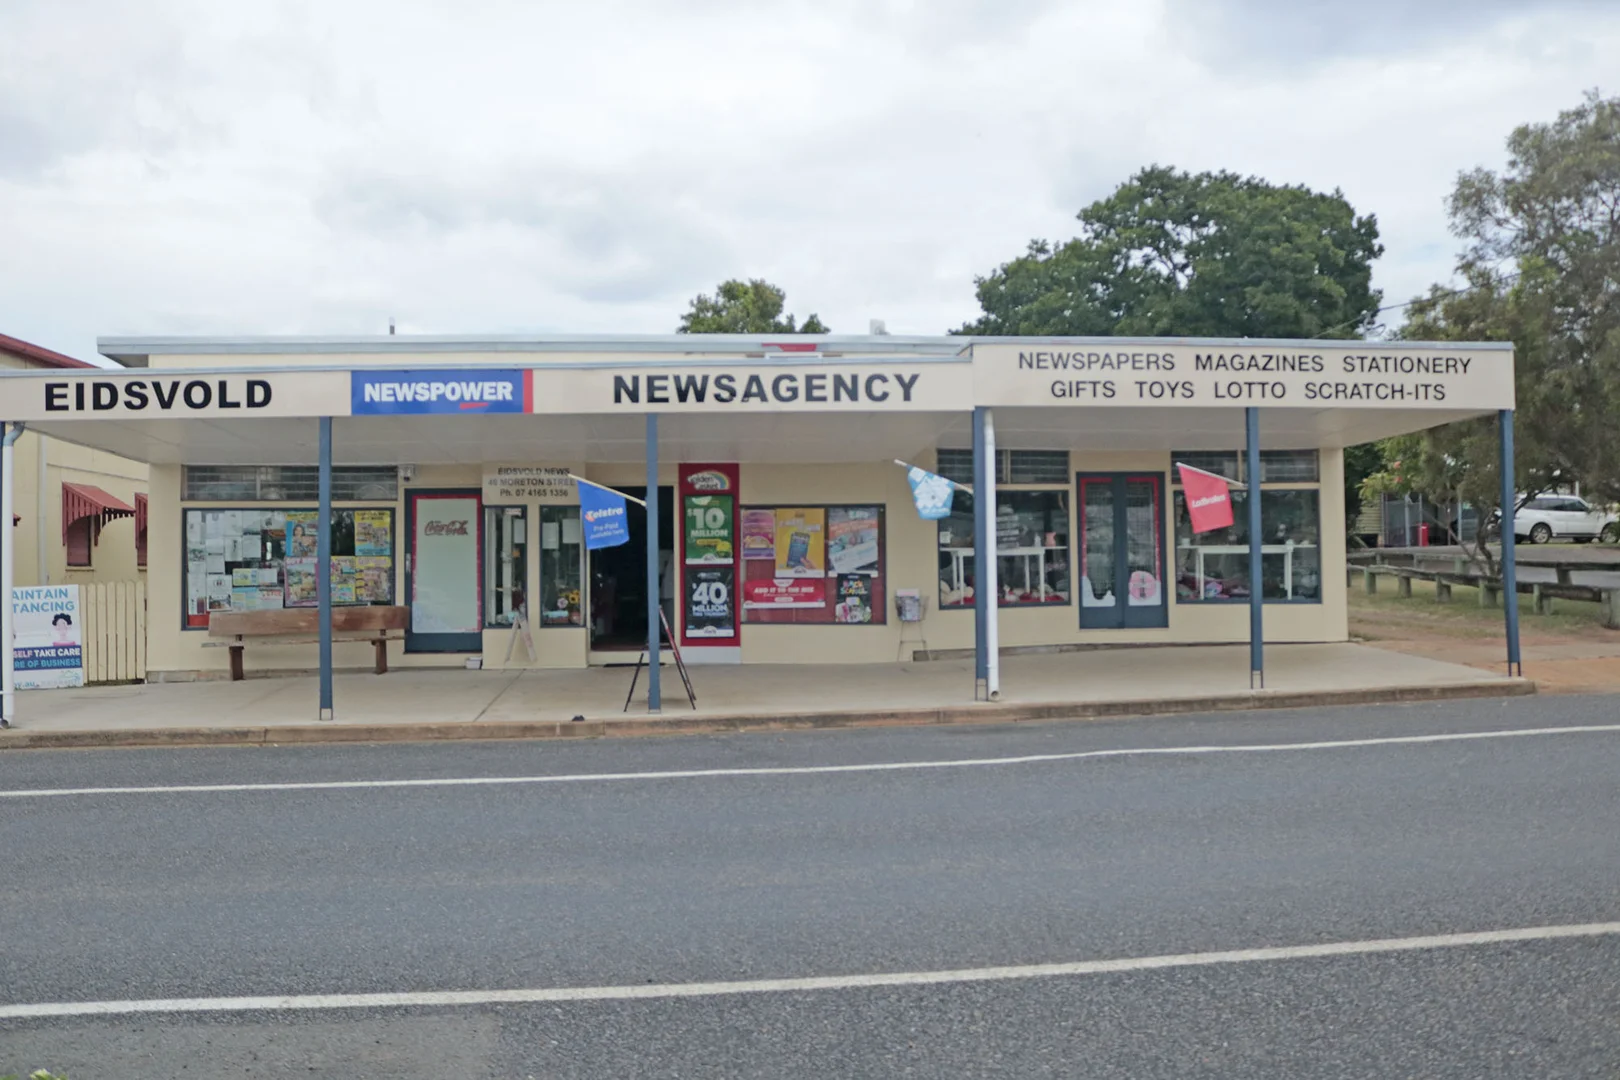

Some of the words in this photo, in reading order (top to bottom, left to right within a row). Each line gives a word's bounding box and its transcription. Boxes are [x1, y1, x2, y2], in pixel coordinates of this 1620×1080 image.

[1018, 352, 1175, 370] NEWSPAPERS
[1195, 353, 1324, 372] MAGAZINES
[1343, 355, 1472, 374] STATIONERY
[364, 381, 513, 402] NEWSPOWER
[613, 373, 920, 404] NEWSAGENCY
[1051, 380, 1116, 398] GIFTS
[1135, 381, 1195, 398] TOYS
[1214, 381, 1286, 399] LOTTO
[1304, 382, 1446, 401] SCRATCH-ITS
[45, 380, 272, 411] EIDSVOLD
[498, 467, 542, 475] EIDSVOLD
[544, 467, 570, 476] NEWS
[500, 478, 544, 486] MORETON
[546, 478, 576, 486] STREE
[515, 488, 525, 496] 07
[586, 507, 624, 520] Telstra
[12, 588, 69, 600] AINTAIN
[12, 601, 75, 613] TANCING
[13, 650, 33, 658] SELF
[34, 648, 56, 657] TAKE
[57, 647, 80, 656] CARE
[14, 660, 25, 668] RE
[41, 658, 80, 667] BUSINESS
